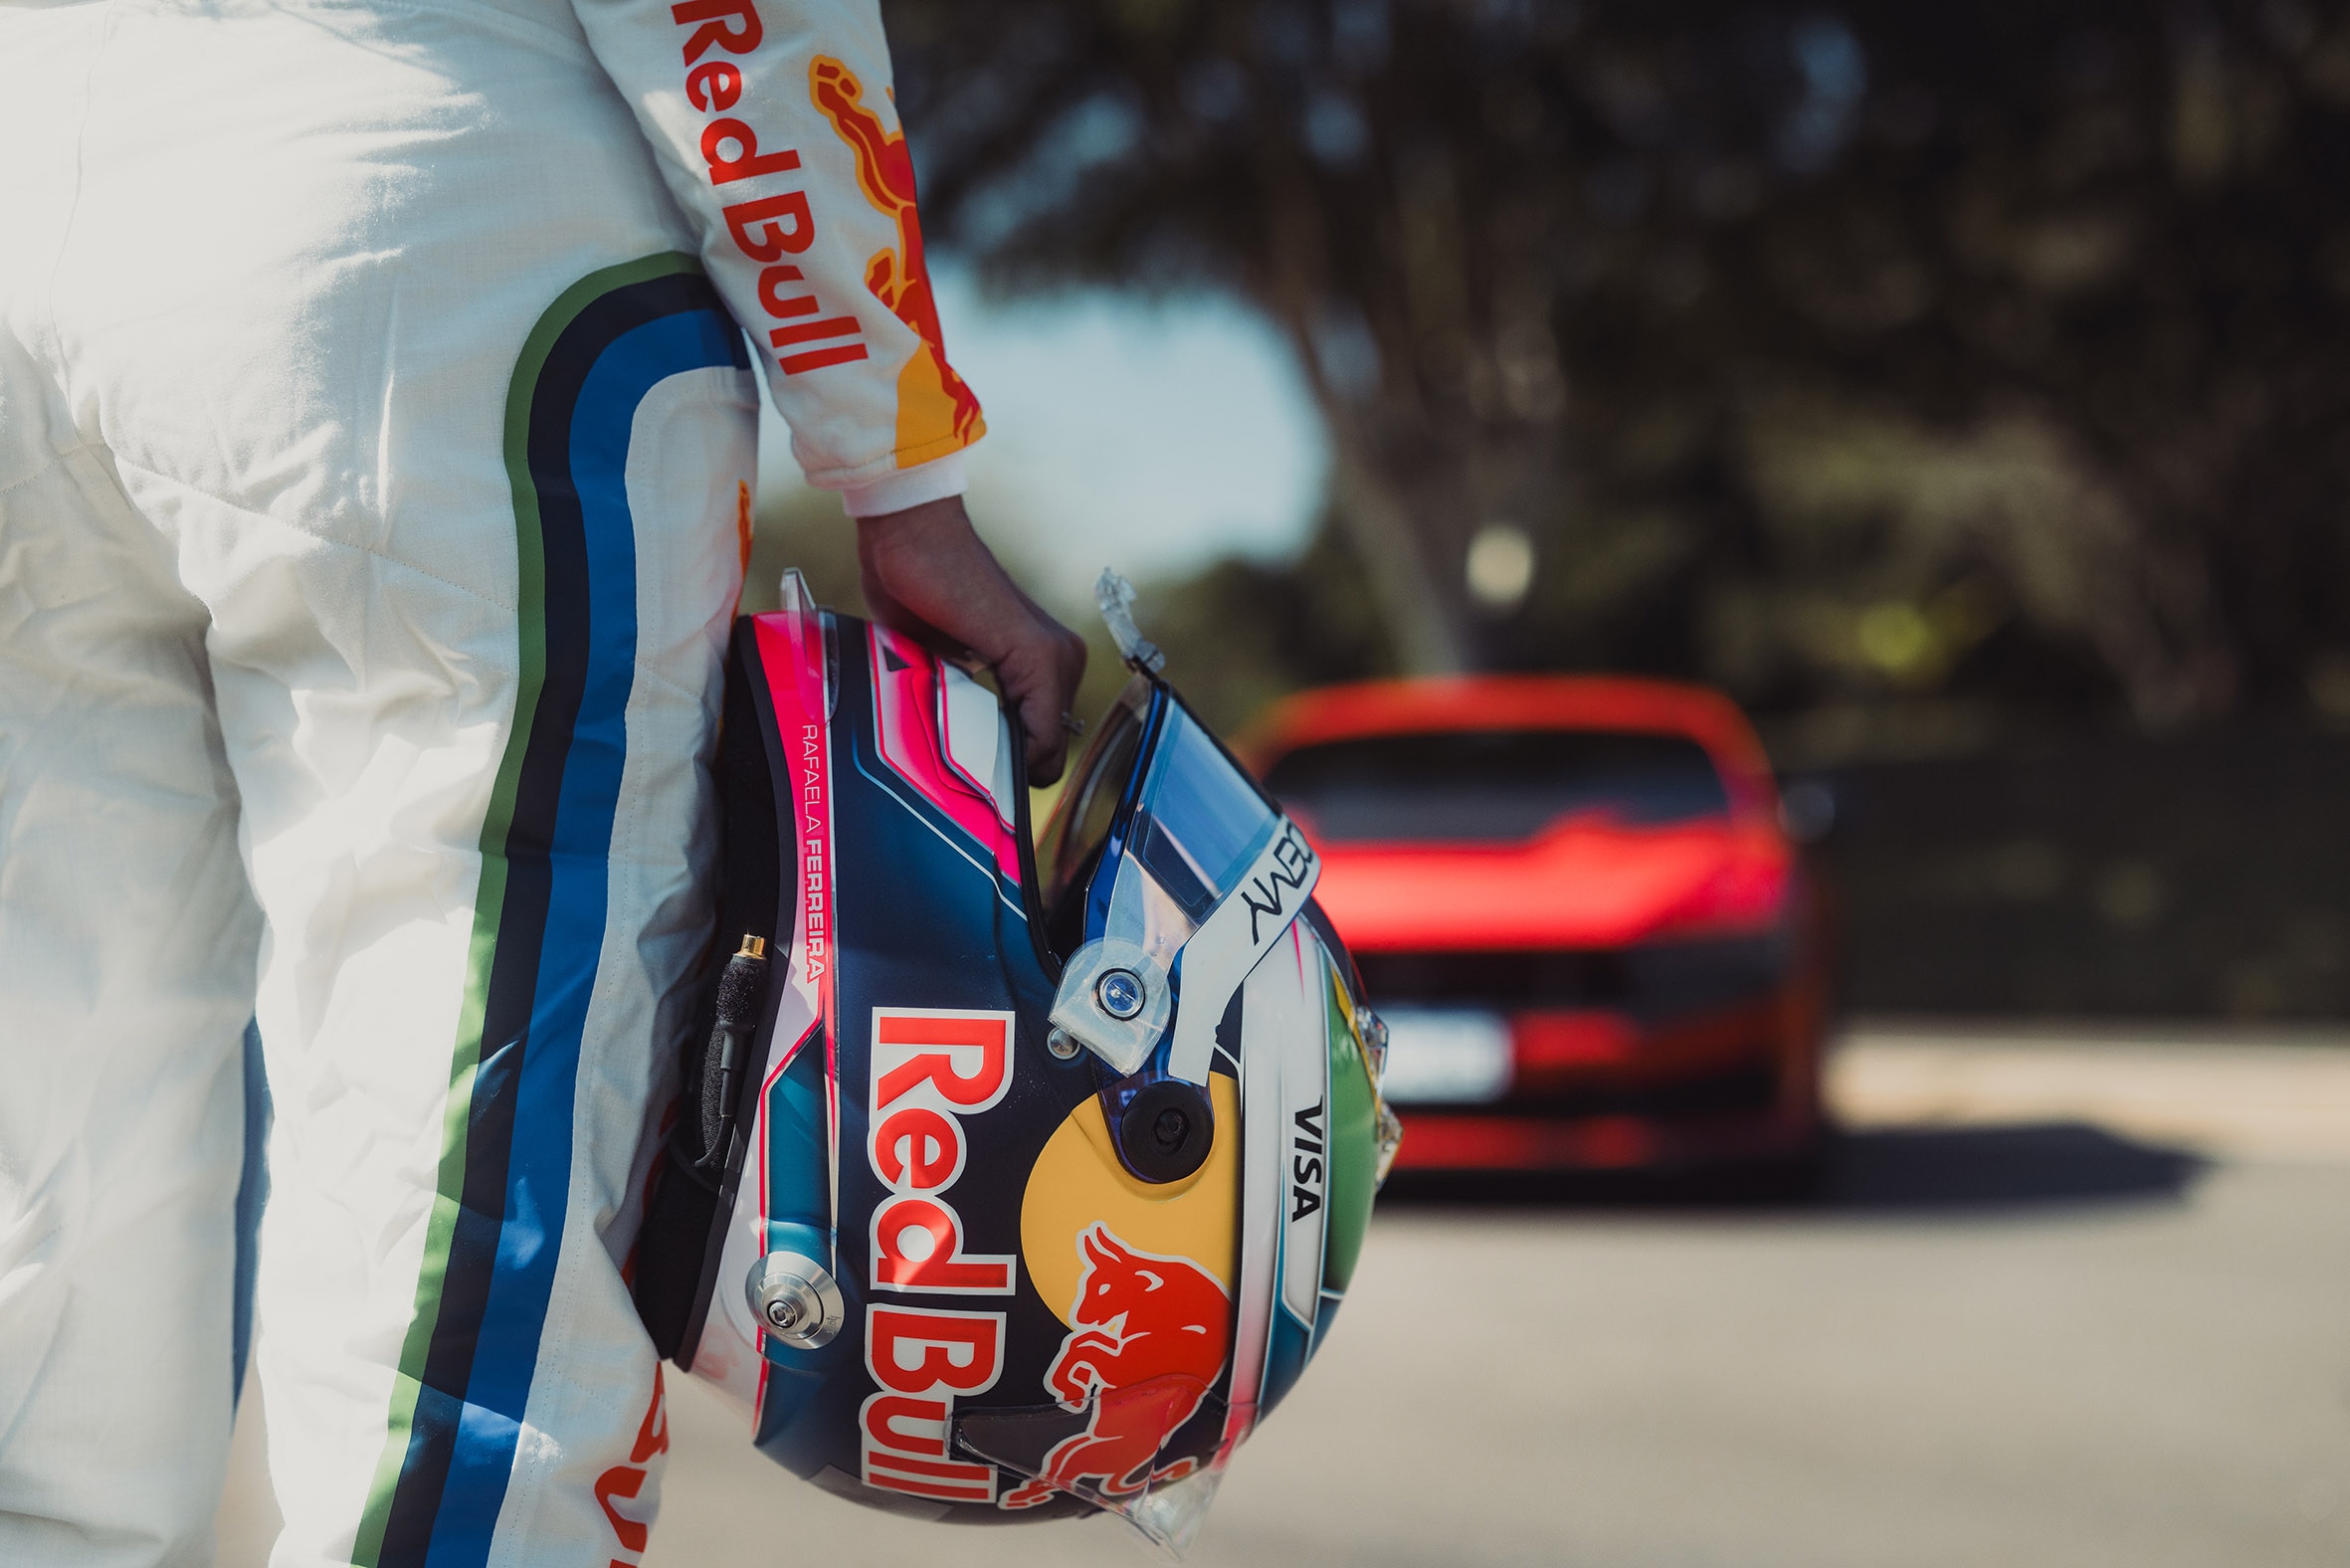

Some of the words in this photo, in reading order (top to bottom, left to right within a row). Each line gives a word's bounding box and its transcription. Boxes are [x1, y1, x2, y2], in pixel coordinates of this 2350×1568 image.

[671, 0, 801, 186] Red
[721, 190, 869, 375] Bull
[802, 724, 822, 834] RAFAELA
[806, 839, 825, 984] FERREIRA
[872, 1013, 1012, 1291] Red
[1291, 1094, 1324, 1224] VISA
[863, 1307, 1002, 1501] Bull
